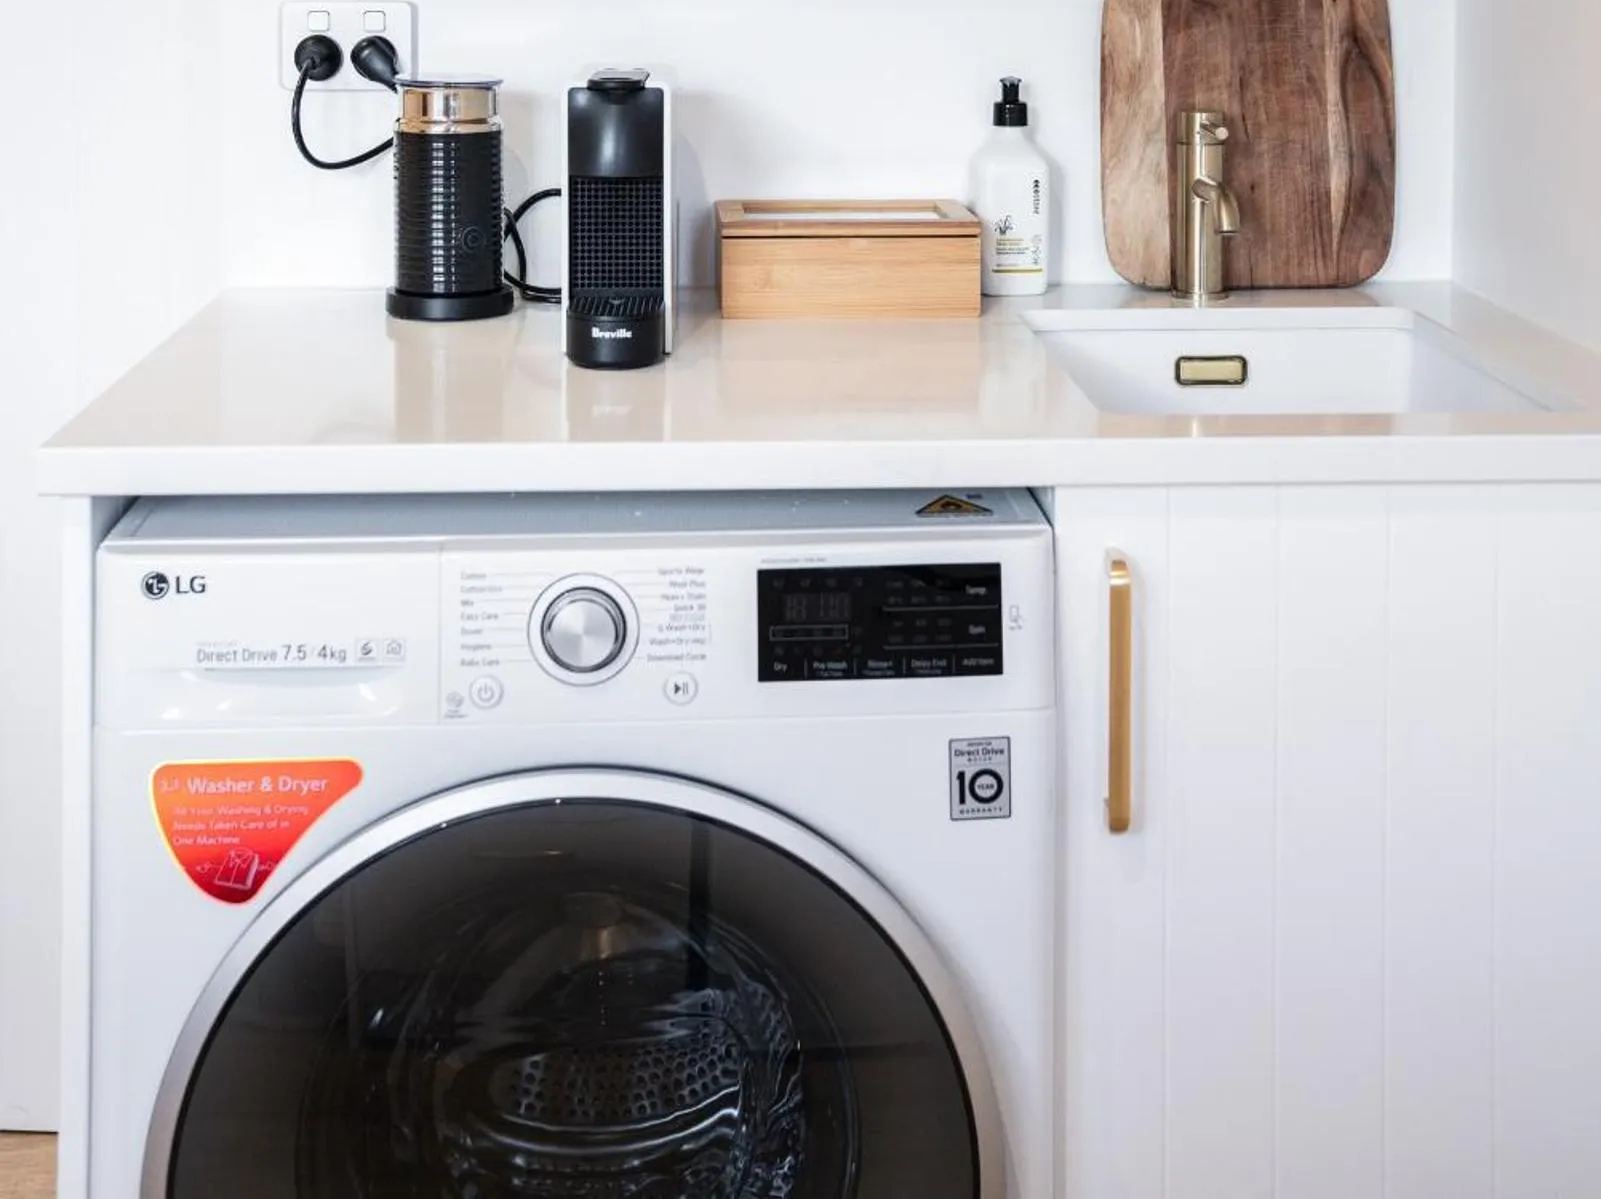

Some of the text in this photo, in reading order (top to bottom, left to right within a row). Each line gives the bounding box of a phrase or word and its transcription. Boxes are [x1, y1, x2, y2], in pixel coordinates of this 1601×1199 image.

[591, 326, 633, 338] Breville
[175, 575, 207, 595] LG
[196, 648, 238, 663] Direct
[242, 648, 278, 663] Drive
[981, 747, 1004, 756] Drive
[186, 776, 255, 794] Washer
[259, 775, 273, 792] &
[278, 775, 328, 797] Dryer
[956, 768, 1004, 805] 10
